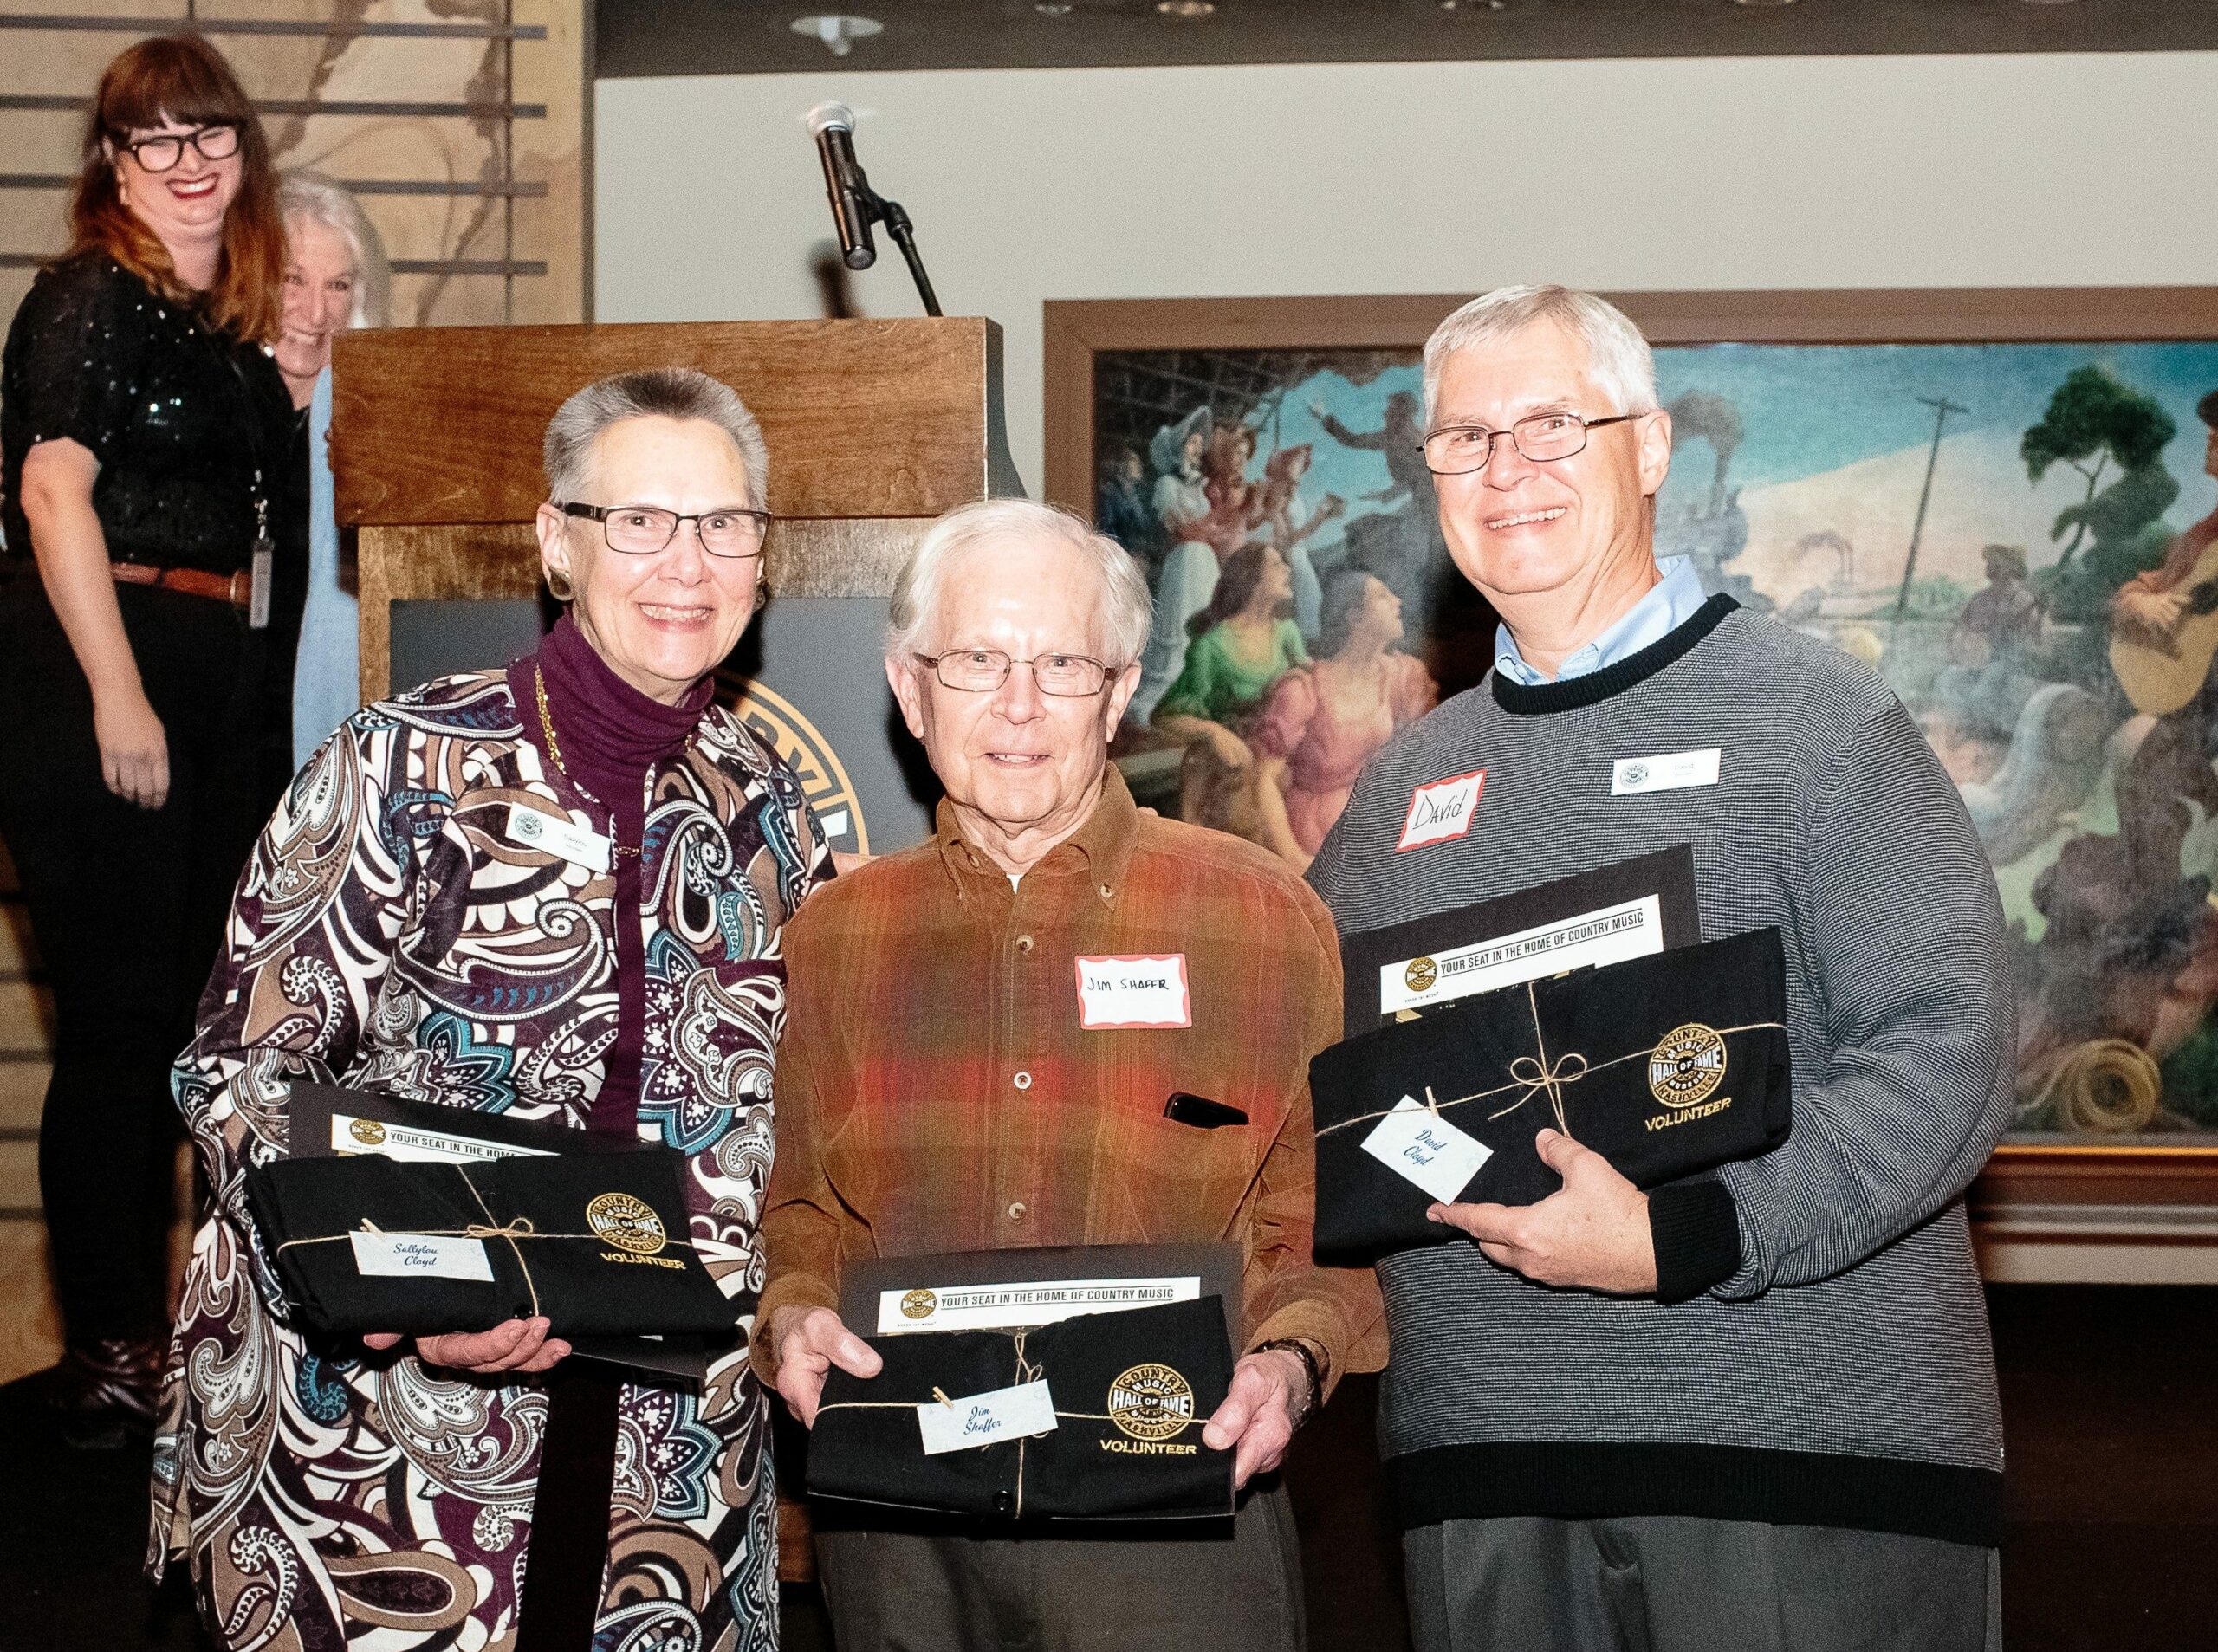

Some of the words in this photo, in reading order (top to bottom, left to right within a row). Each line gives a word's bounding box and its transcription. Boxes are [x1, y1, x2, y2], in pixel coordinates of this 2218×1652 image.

[1441, 962, 1466, 975] YOUR
[1469, 953, 1489, 969] SEAT
[1493, 950, 1503, 962] IN
[1505, 944, 1522, 958] THE
[1524, 936, 1552, 954] HOME
[1554, 932, 1566, 946] OF
[1568, 921, 1611, 942] COUNTRY
[1612, 912, 1644, 930] MUSIC
[1667, 1041, 1704, 1059] MUSIC
[1652, 1063, 1679, 1086] HALL
[1680, 1061, 1693, 1071] OF
[1694, 1045, 1722, 1070] FAME
[1645, 1097, 1732, 1132] VOLUNTEER
[391, 1132, 418, 1144] YOUR
[422, 1137, 445, 1150] SEAT
[450, 1143, 460, 1152] IN
[463, 1144, 483, 1156] THE
[1414, 1129, 1449, 1151] David
[1404, 1145, 1435, 1166] Cloyd
[593, 1196, 652, 1216] COUNTRY
[591, 1214, 619, 1231] HALL
[634, 1218, 663, 1237] FAME
[393, 1242, 438, 1256] Sallylou
[404, 1255, 437, 1268] Cloyd
[600, 1253, 686, 1270] VOLUNTEER
[942, 1296, 969, 1307] YOUR
[972, 1294, 996, 1305] SEAT
[1000, 1293, 1010, 1304] IN
[1014, 1292, 1033, 1303] THE
[1036, 1291, 1067, 1302] HOME
[1071, 1291, 1084, 1300] OF
[1087, 1289, 1135, 1300] COUNTRY
[1138, 1288, 1174, 1299] MUSIC
[1121, 1369, 1186, 1392] COUNTRY
[1132, 1379, 1172, 1394] MUSIC
[1112, 1388, 1143, 1412] HALL
[1144, 1397, 1158, 1406] OF
[1159, 1396, 1190, 1418] FAME
[968, 1406, 990, 1422] Jim
[963, 1417, 1002, 1435] Shaffer
[1099, 1439, 1197, 1454] VOLUNTEER
